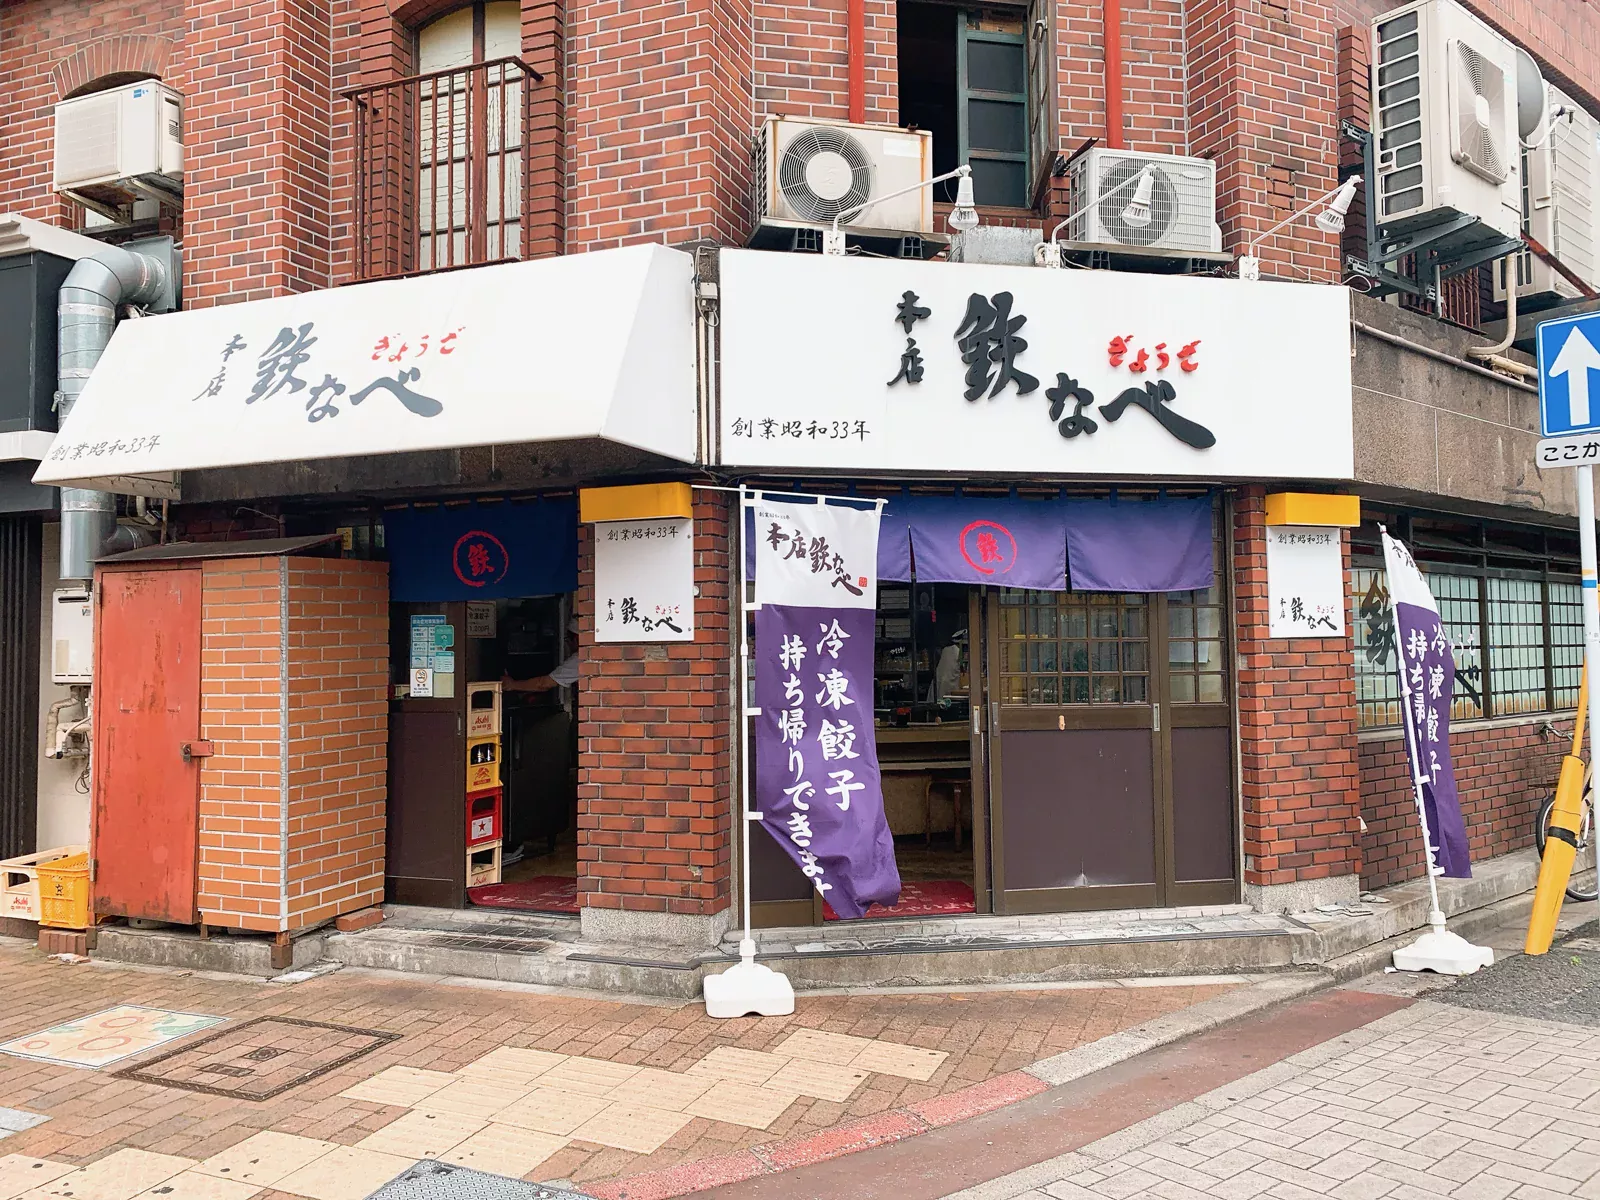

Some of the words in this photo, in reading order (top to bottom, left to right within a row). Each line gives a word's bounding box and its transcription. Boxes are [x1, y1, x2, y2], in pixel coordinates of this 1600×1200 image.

[887, 290, 931, 387] 本店
[1108, 333, 1201, 373] ぎょうざ
[192, 334, 247, 401] 本店
[245, 322, 443, 423] 鉄なべ
[953, 291, 1216, 450] 鉄なべ
[51, 435, 161, 462] 創業昭和33年
[730, 416, 872, 442] 創業昭和33年
[607, 525, 680, 541] 創業昭和33年
[1277, 533, 1332, 545] 創業昭和33年
[620, 596, 683, 633] 鉄なべ
[815, 617, 865, 812] 冷凍餃子
